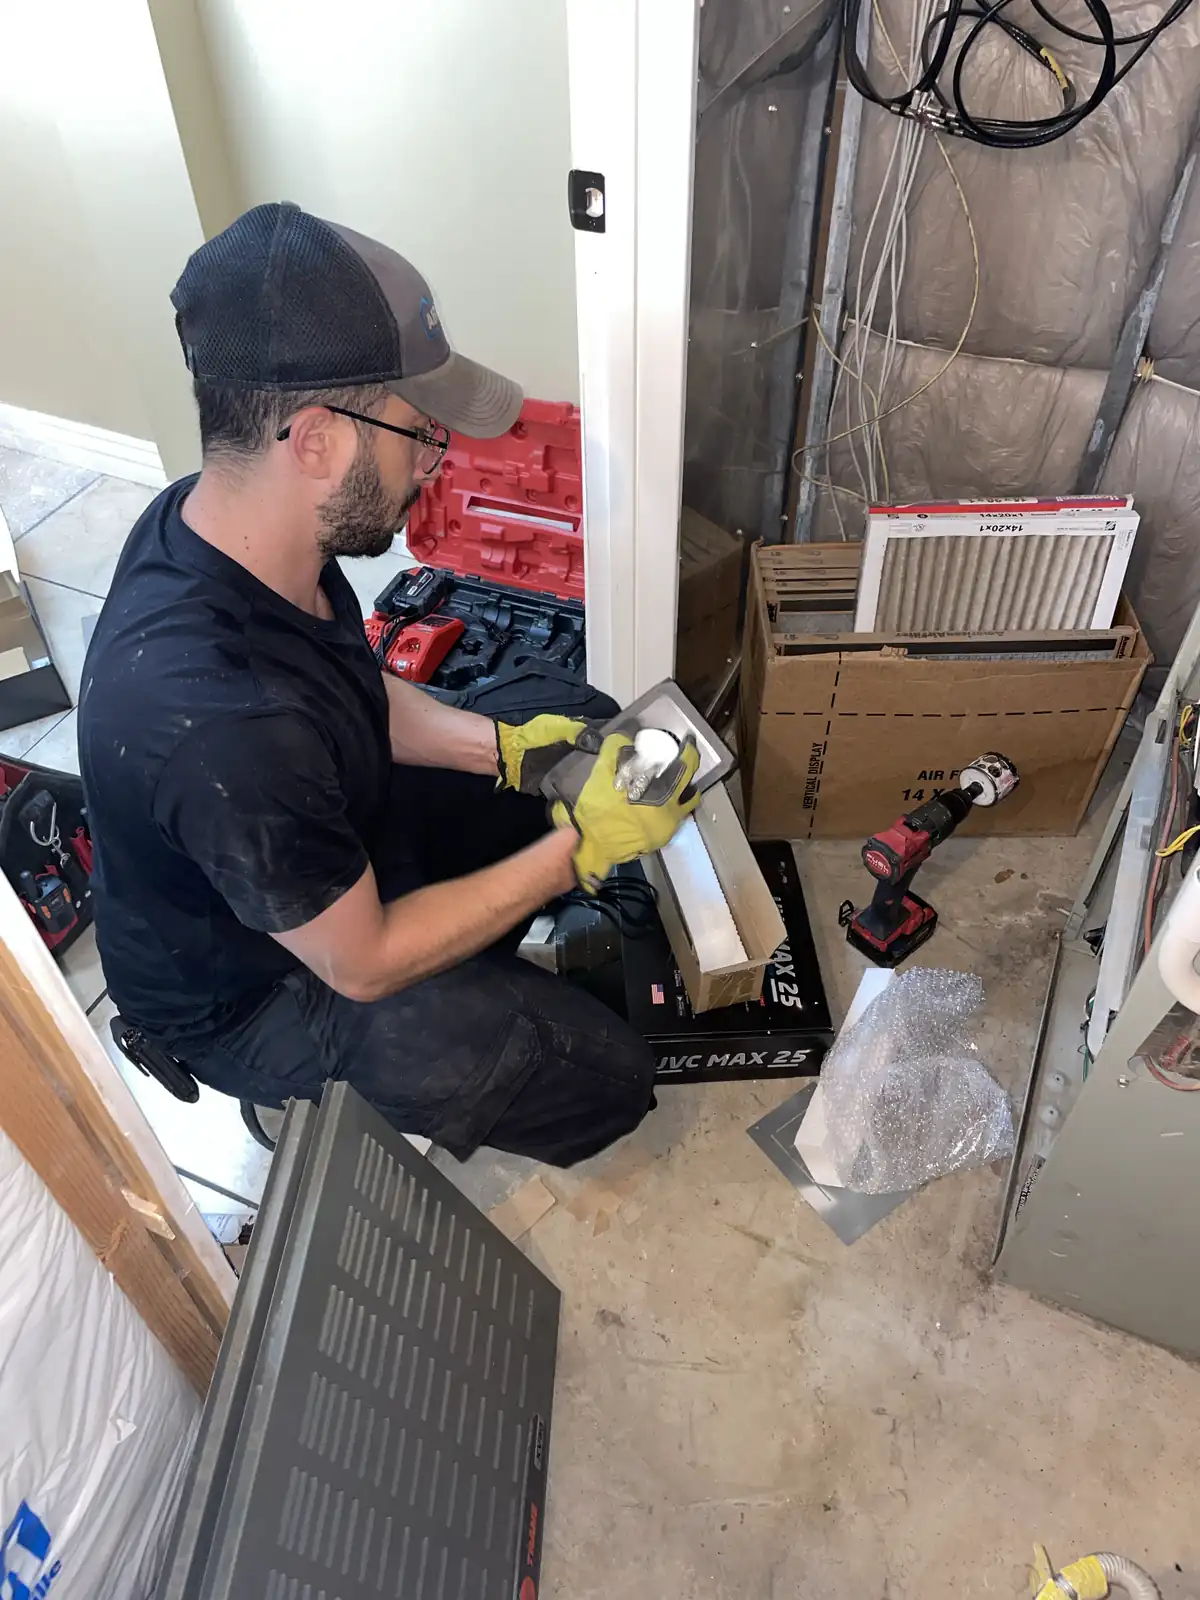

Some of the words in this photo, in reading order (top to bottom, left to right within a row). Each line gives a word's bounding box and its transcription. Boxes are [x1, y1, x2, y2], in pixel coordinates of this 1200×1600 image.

[979, 524, 1025, 533] 14x20x1
[807, 742, 823, 775] DISPLAY
[917, 769, 945, 781] AIR
[802, 776, 817, 809] VERTICAL
[901, 788, 925, 802] 14
[778, 981, 804, 1010] 25
[706, 1051, 769, 1068] MAX
[772, 1049, 812, 1064] 25
